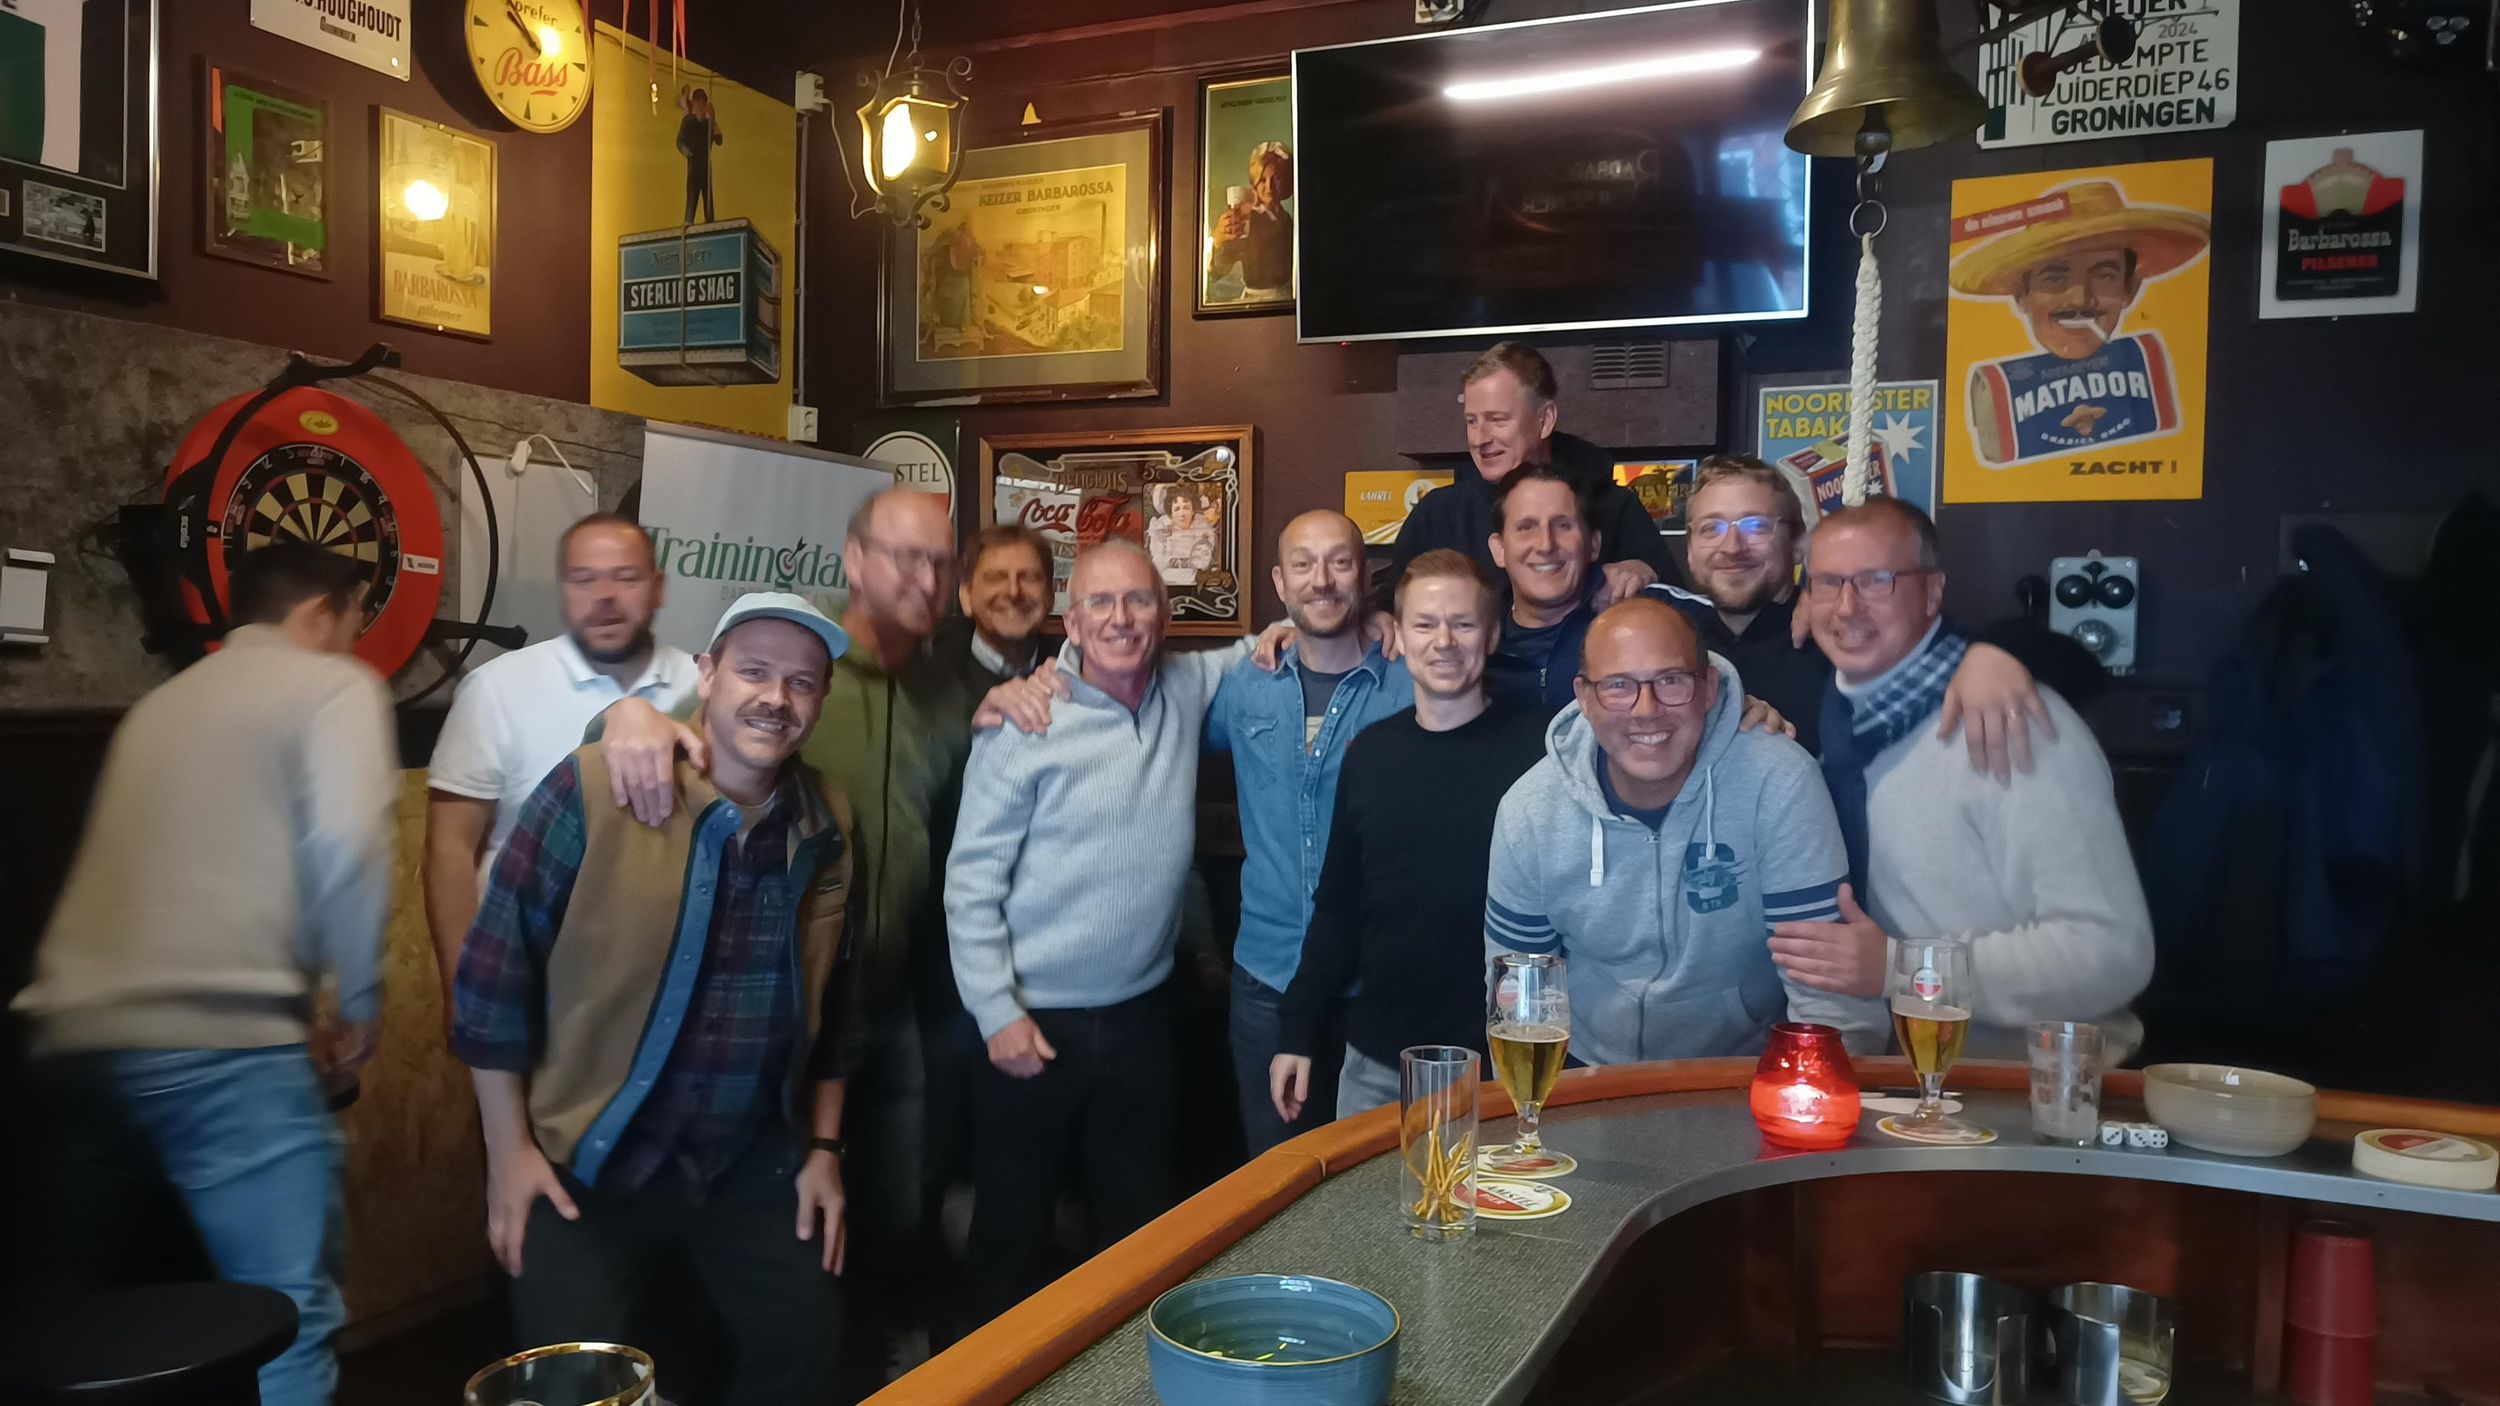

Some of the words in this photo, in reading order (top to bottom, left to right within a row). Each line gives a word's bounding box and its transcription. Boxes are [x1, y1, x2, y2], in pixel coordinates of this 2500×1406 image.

[2158, 22, 2199, 38] 2024
[494, 47, 568, 87] Bass
[2197, 68, 2230, 91] 46
[979, 191, 1022, 207] KEIZER
[1027, 181, 1114, 202] BARBAROSSA
[2288, 229, 2392, 251] Barbarossa
[2301, 255, 2379, 271] PILSENER
[699, 275, 735, 302] SHAG
[1766, 388, 1930, 415] NOORSTER
[2014, 371, 2149, 423] MATADOR
[1766, 415, 1849, 439] TABAK
[895, 463, 942, 482] STEL
[2070, 460, 2164, 476] ZACHT
